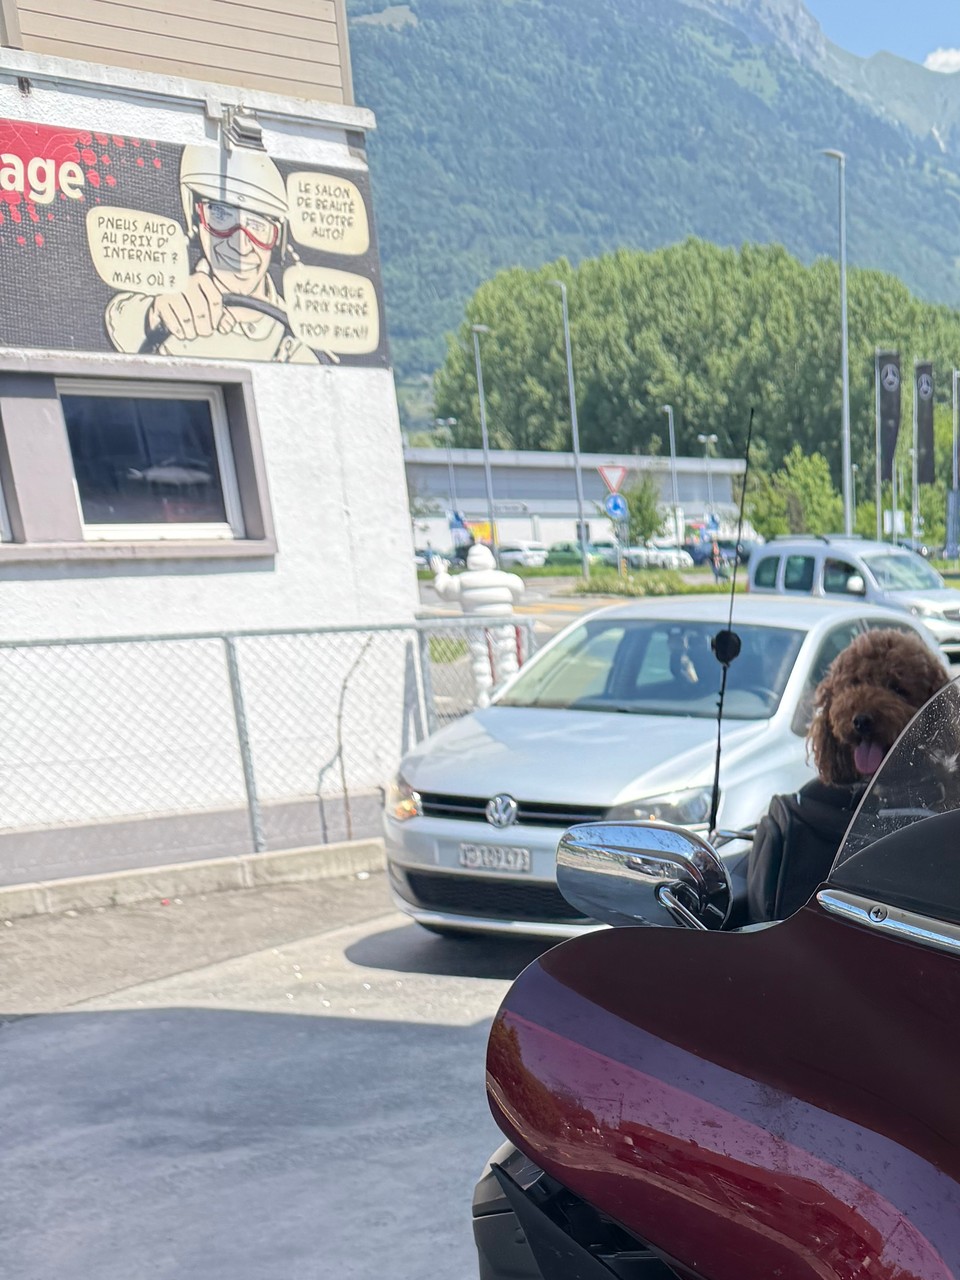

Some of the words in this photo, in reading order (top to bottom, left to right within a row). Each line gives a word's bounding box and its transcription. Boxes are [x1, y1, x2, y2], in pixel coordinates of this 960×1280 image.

[0, 153, 85, 205] age
[299, 181, 311, 194] LE
[315, 184, 350, 199] SALON
[297, 196, 312, 208] DE
[316, 199, 355, 214] BEAUTÉ
[98, 216, 138, 232] PNEUS
[143, 221, 176, 236] AUTO
[302, 211, 316, 223] DE
[319, 211, 354, 228] VOTRE
[101, 231, 117, 244] AU
[122, 233, 153, 248] PRIX
[157, 237, 169, 248] D'
[312, 226, 345, 241] AUTO!
[103, 246, 167, 263] INTERNET
[172, 252, 178, 264] ?
[112, 271, 142, 285] MAIS
[147, 270, 164, 286] OÙ
[169, 275, 176, 287] ?
[305, 299, 329, 313] PRIX
[300, 323, 329, 337] TROP
